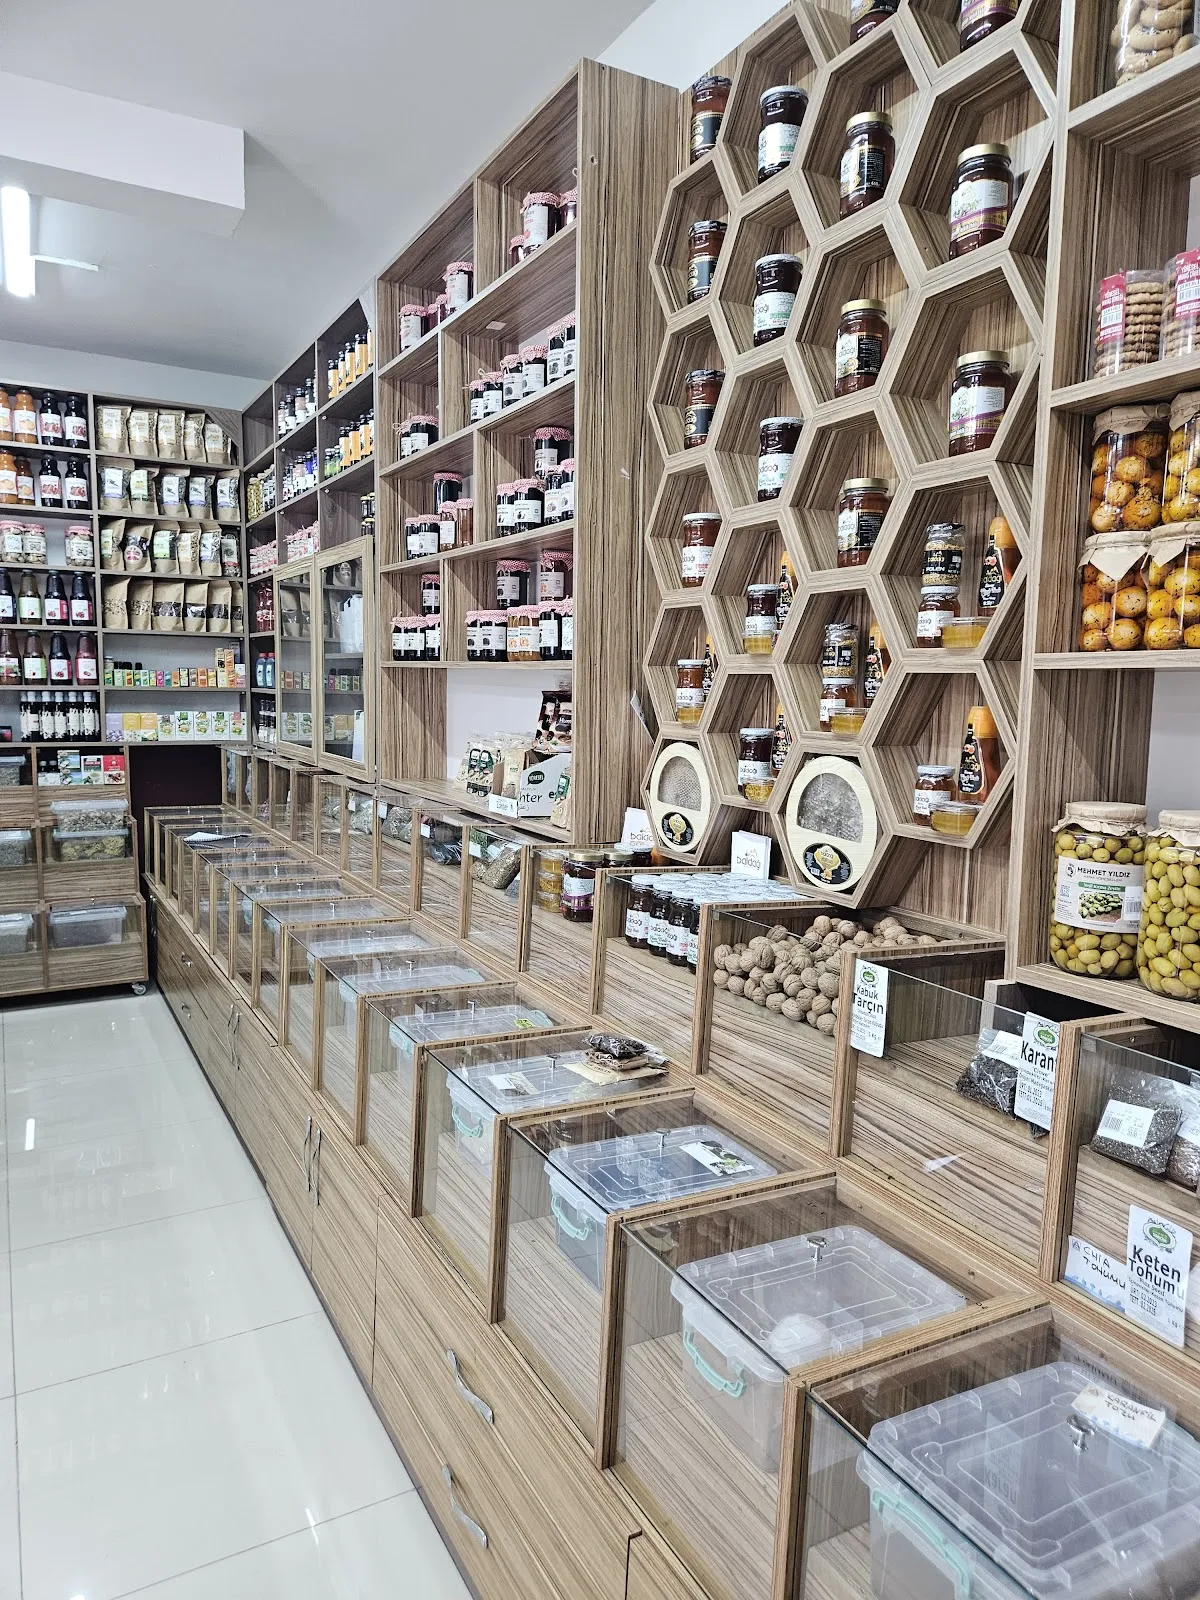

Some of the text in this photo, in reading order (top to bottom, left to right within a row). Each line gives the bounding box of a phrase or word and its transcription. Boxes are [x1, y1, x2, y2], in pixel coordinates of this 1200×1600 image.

[1077, 867, 1131, 878] MEHMET YILDIZ
[853, 992, 884, 1014] Tarçın
[857, 984, 878, 1000] Kabuk
[1020, 1040, 1054, 1072] Karan
[1132, 1244, 1181, 1282] Keten
[1128, 1257, 1185, 1300] Tohumu
